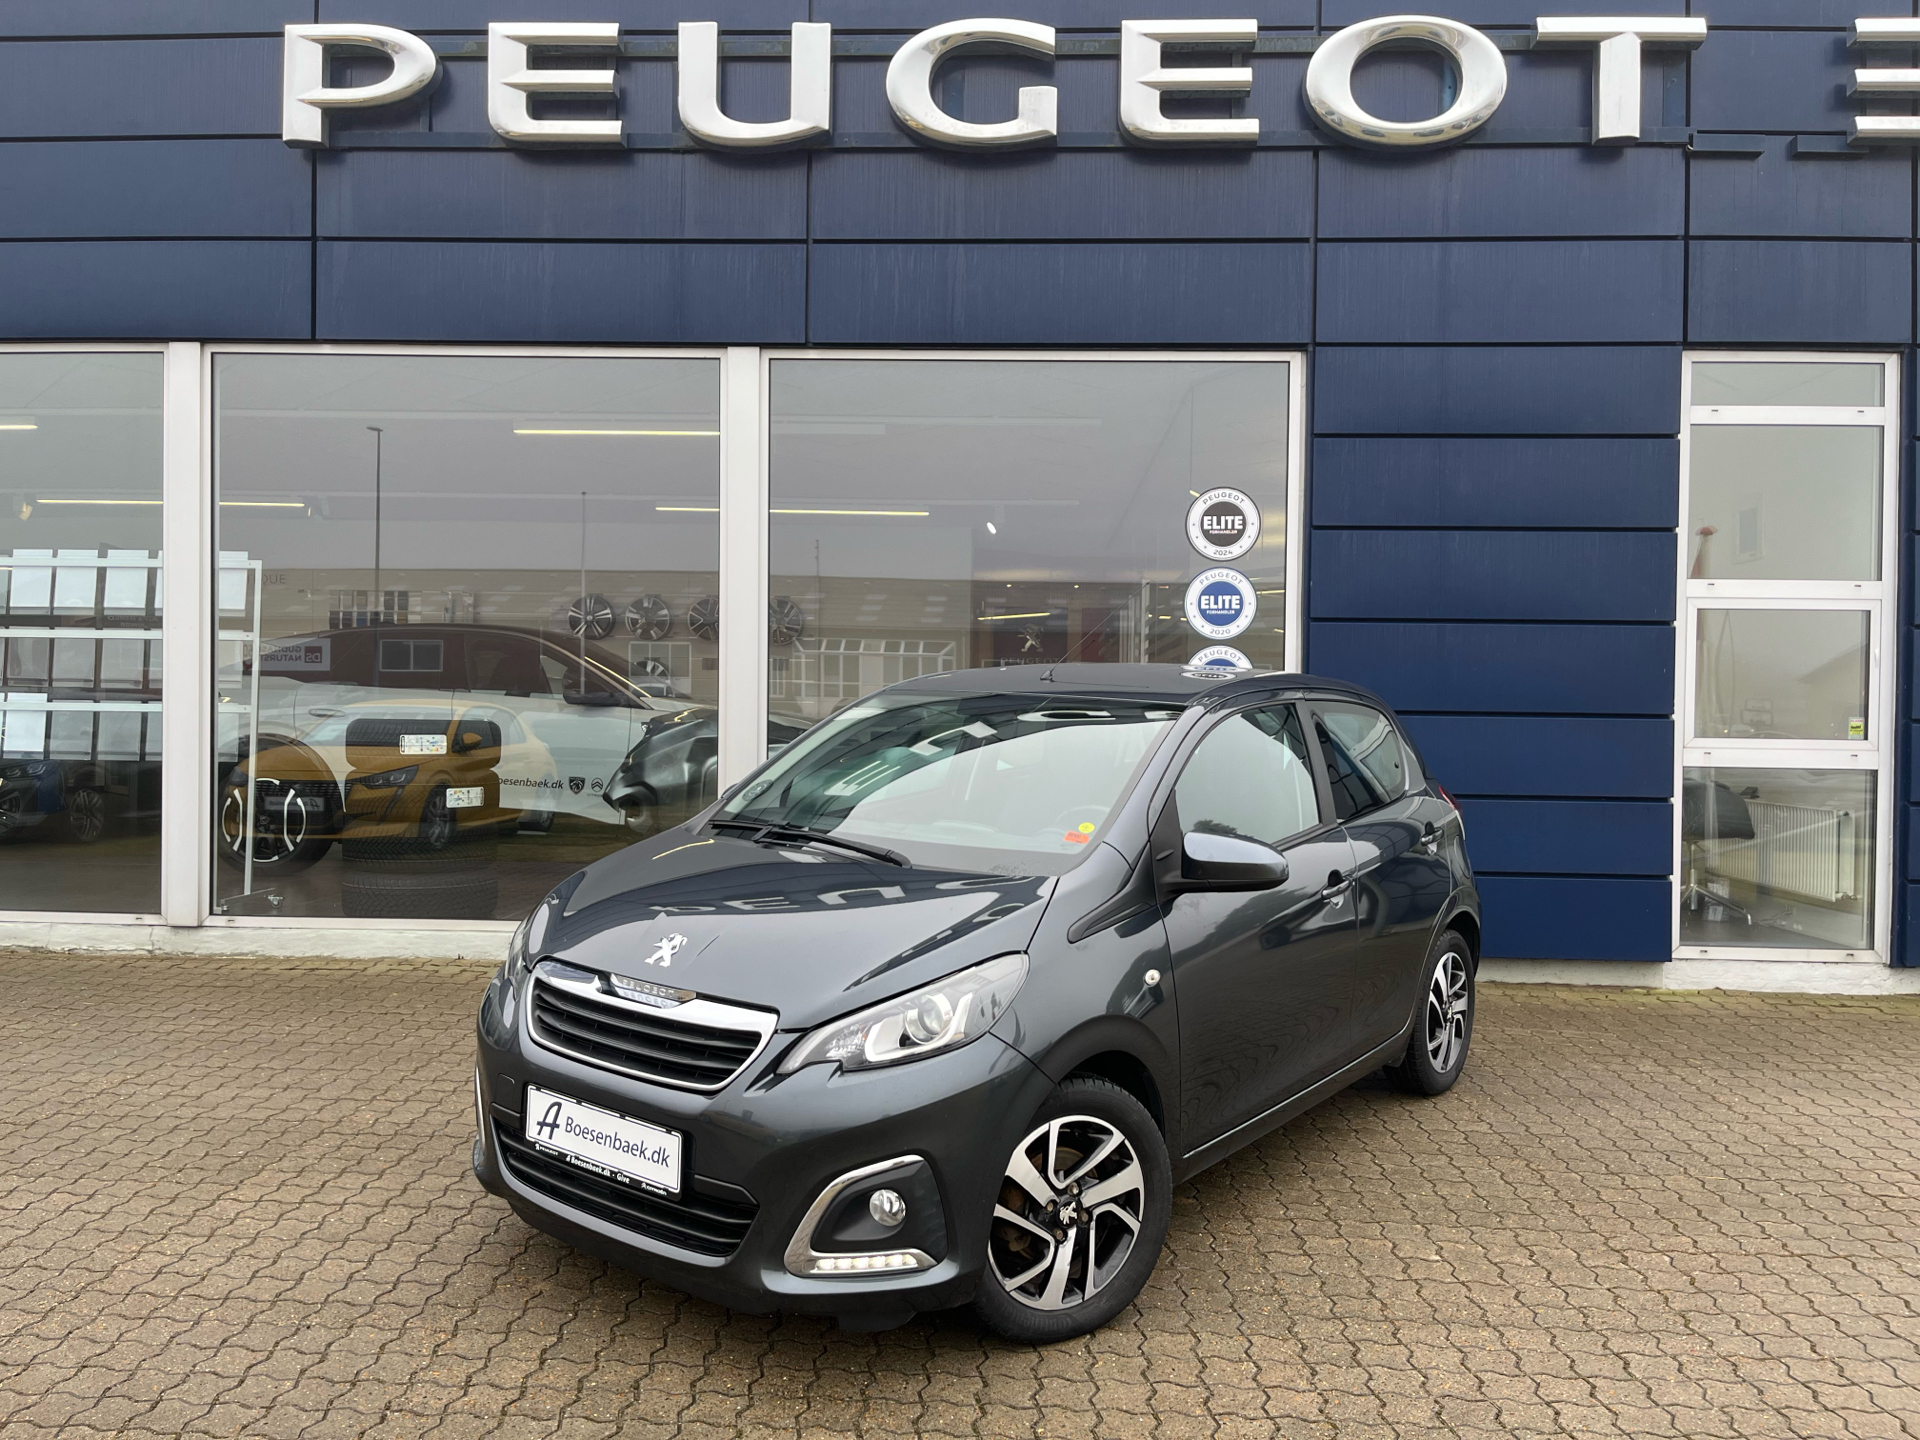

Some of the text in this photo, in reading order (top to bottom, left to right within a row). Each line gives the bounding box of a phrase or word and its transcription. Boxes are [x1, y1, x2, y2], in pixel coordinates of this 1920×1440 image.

[282, 18, 1708, 149] PEUGEOT
[1202, 491, 1245, 505] PEUGEOT
[1203, 515, 1244, 530] ELITE
[1199, 571, 1244, 586] PEUGEOT
[1200, 595, 1241, 609] ELITE
[1198, 649, 1242, 663] PEUGEOT
[499, 778, 565, 790] oesenbaek.dk
[622, 979, 675, 998] PEUGEOT
[564, 1115, 671, 1168] Boesenbaek.dk
